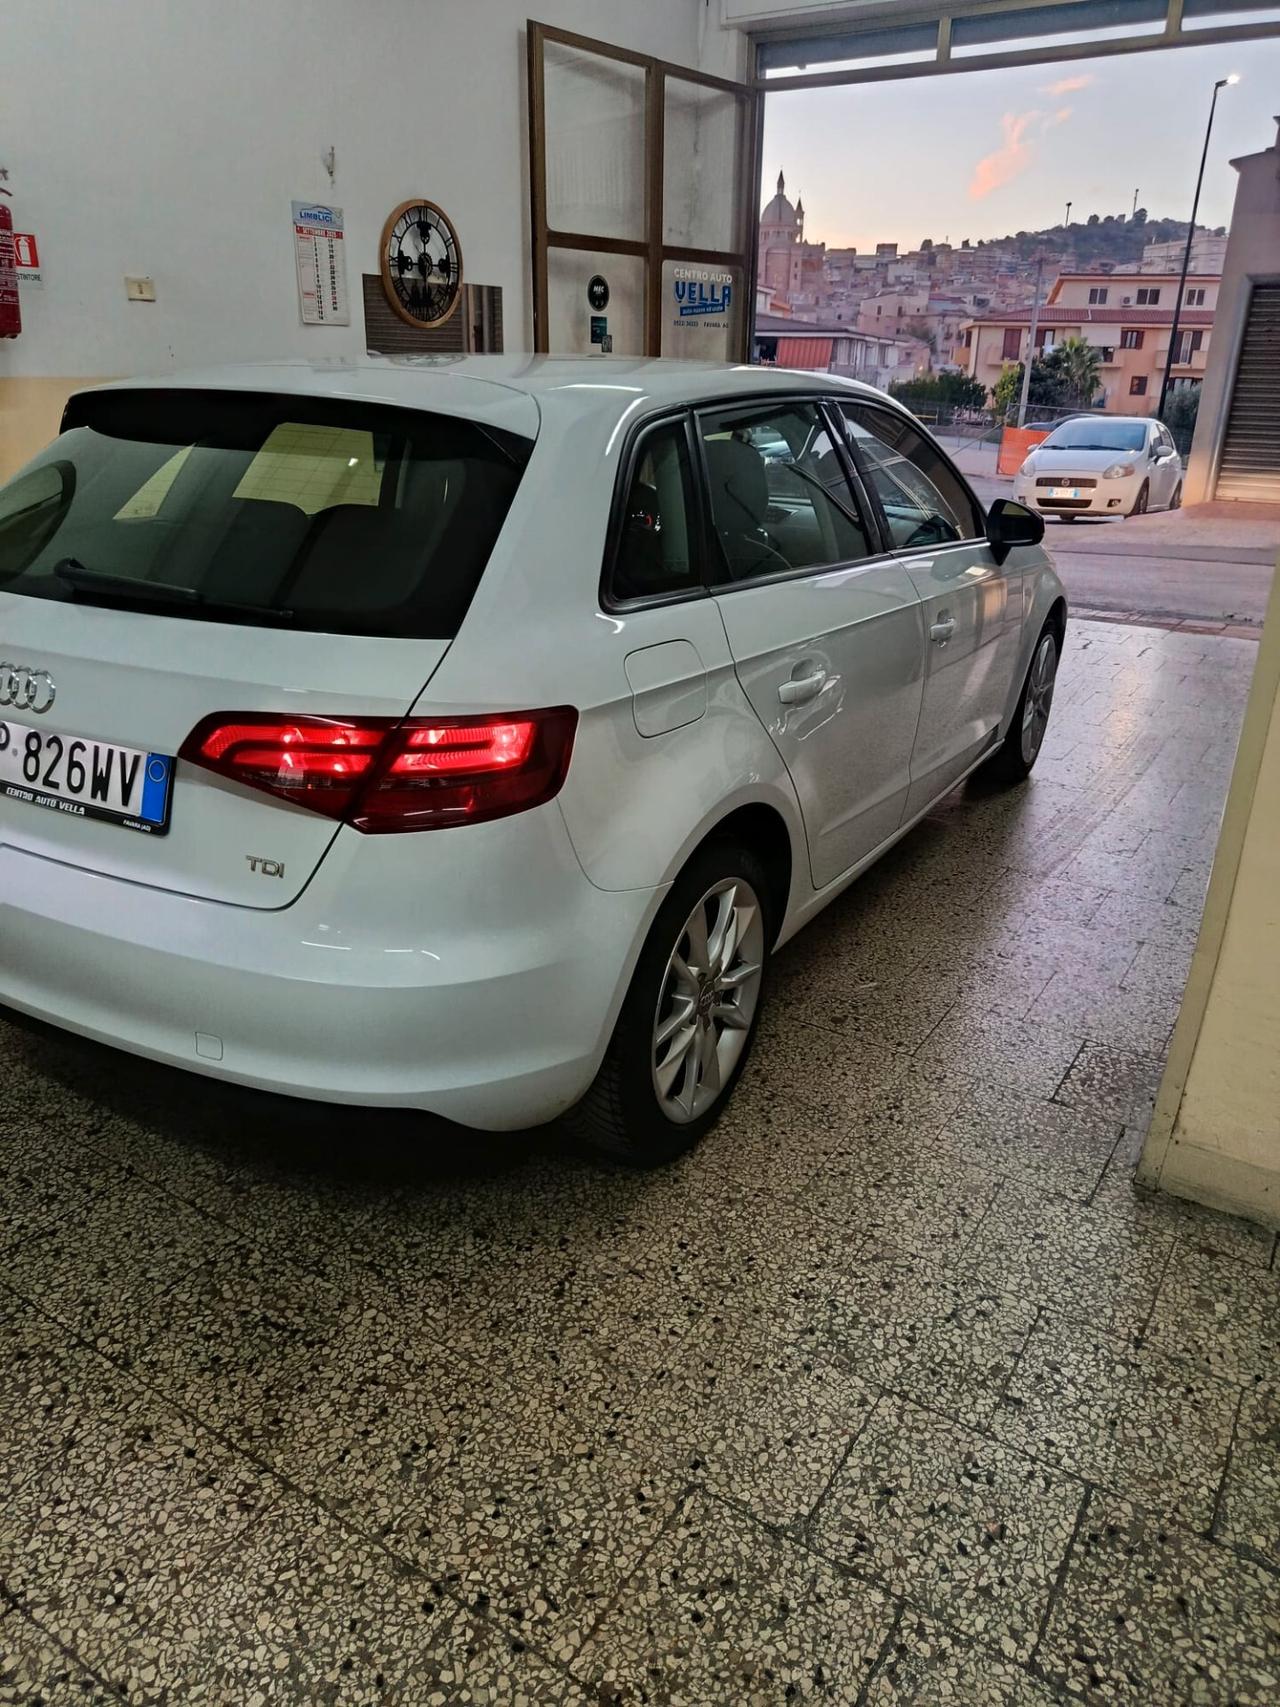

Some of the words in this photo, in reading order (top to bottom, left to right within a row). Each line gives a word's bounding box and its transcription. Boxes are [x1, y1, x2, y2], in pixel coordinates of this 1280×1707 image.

[673, 267, 709, 281] CENTRO
[710, 271, 733, 284] AUTO
[674, 281, 732, 307] VELLA
[6, 787, 34, 801] CENTRO
[35, 795, 57, 808] AUTO
[59, 801, 85, 815] VELLA
[246, 854, 285, 879] TDI
